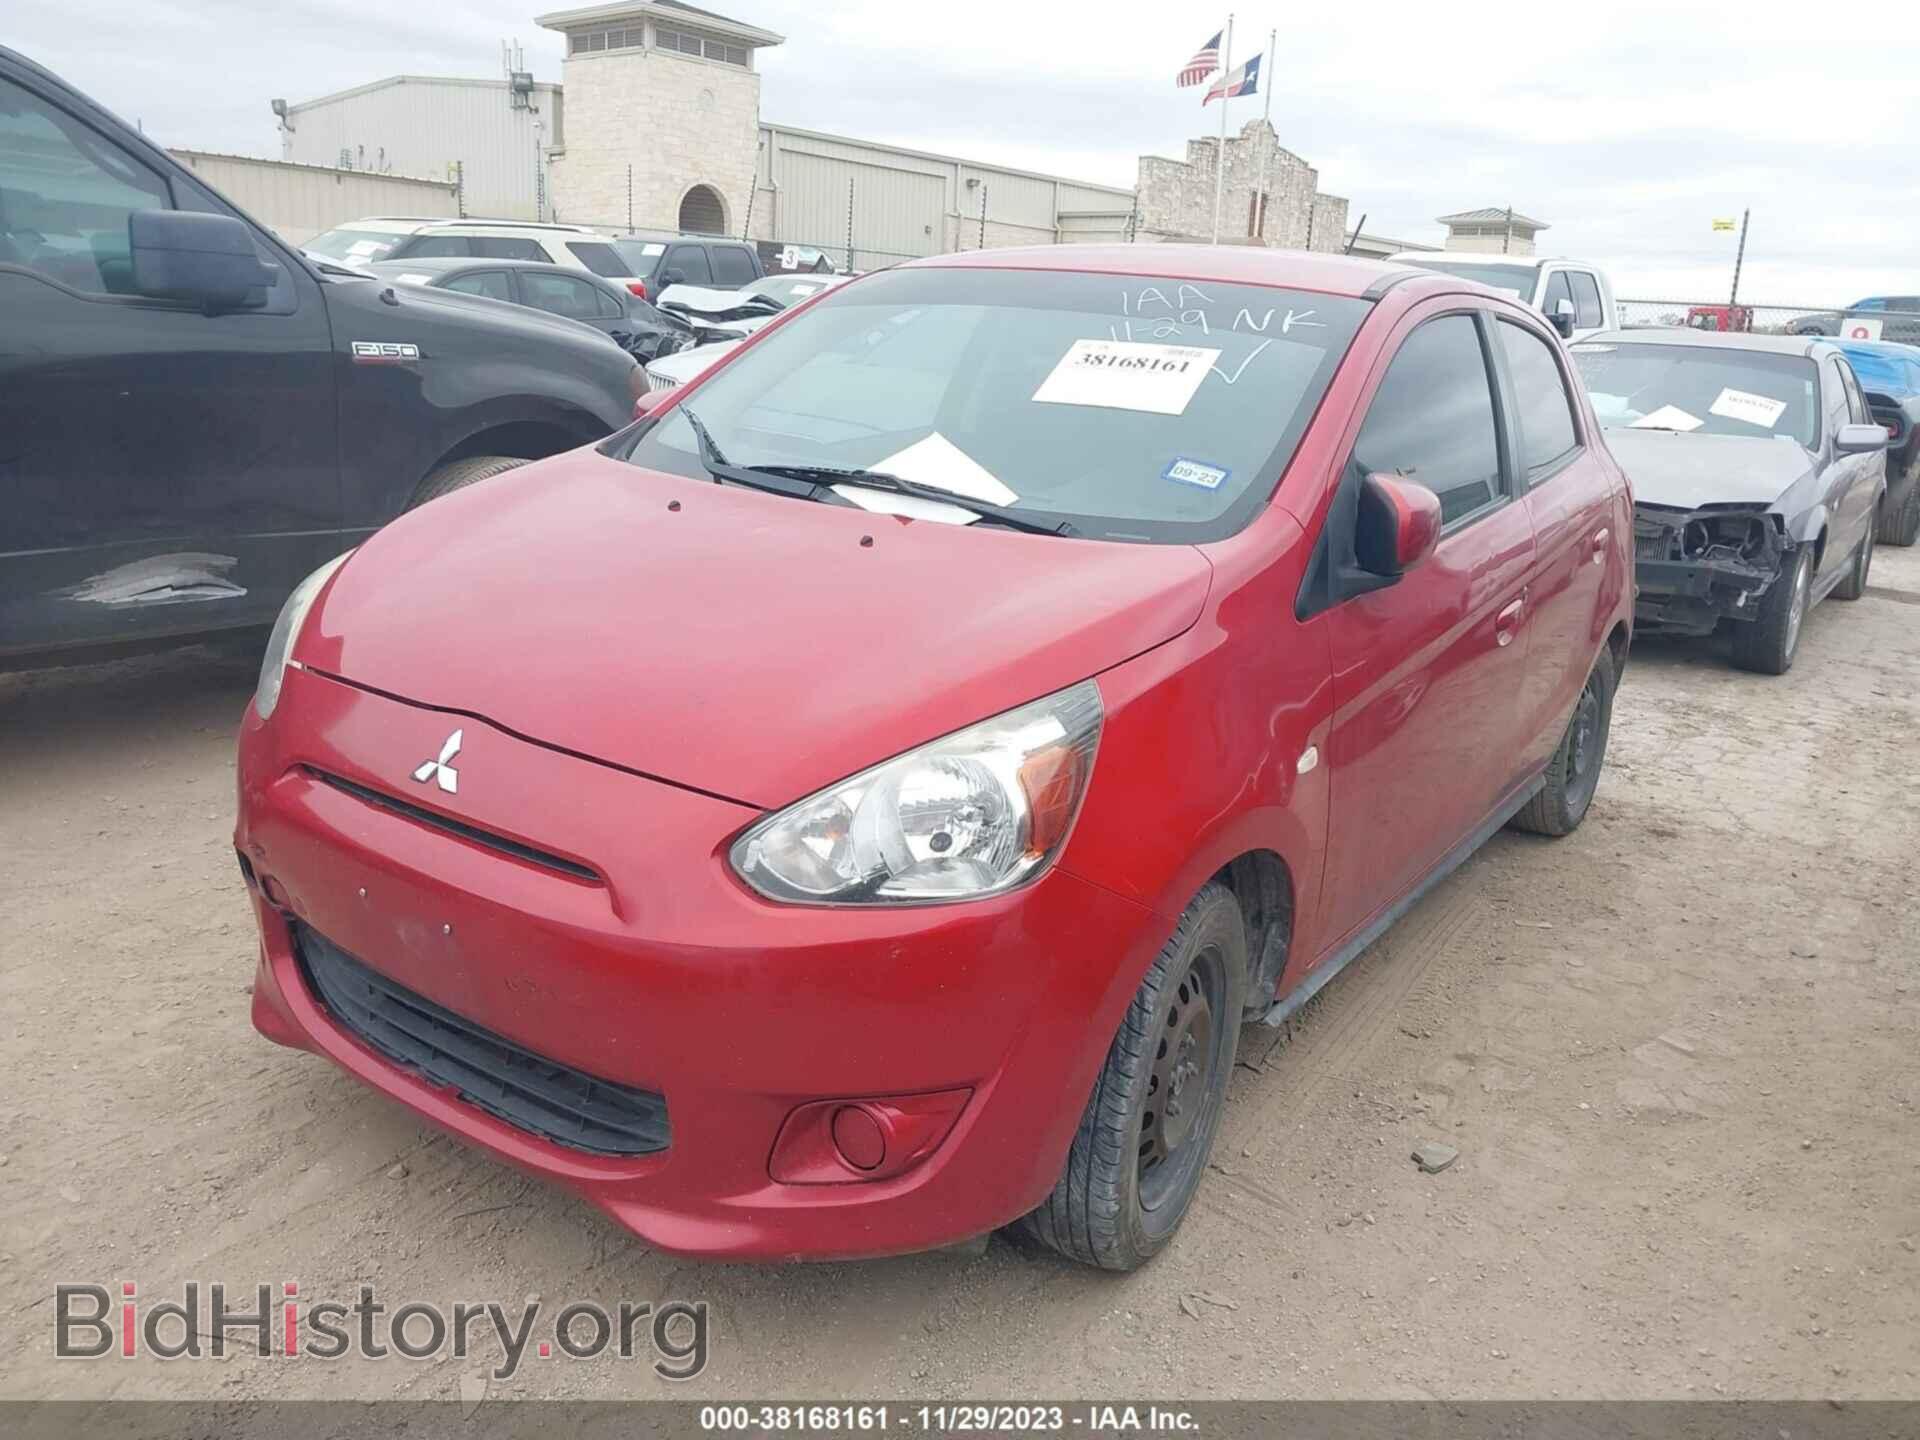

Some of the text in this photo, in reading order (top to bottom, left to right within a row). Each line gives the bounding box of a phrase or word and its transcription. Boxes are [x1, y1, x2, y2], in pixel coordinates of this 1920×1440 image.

[786, 250, 794, 265] 3
[1123, 284, 1215, 315] IAA
[1110, 308, 1327, 342] 11-29 NK
[1075, 353, 1190, 373] 38168161
